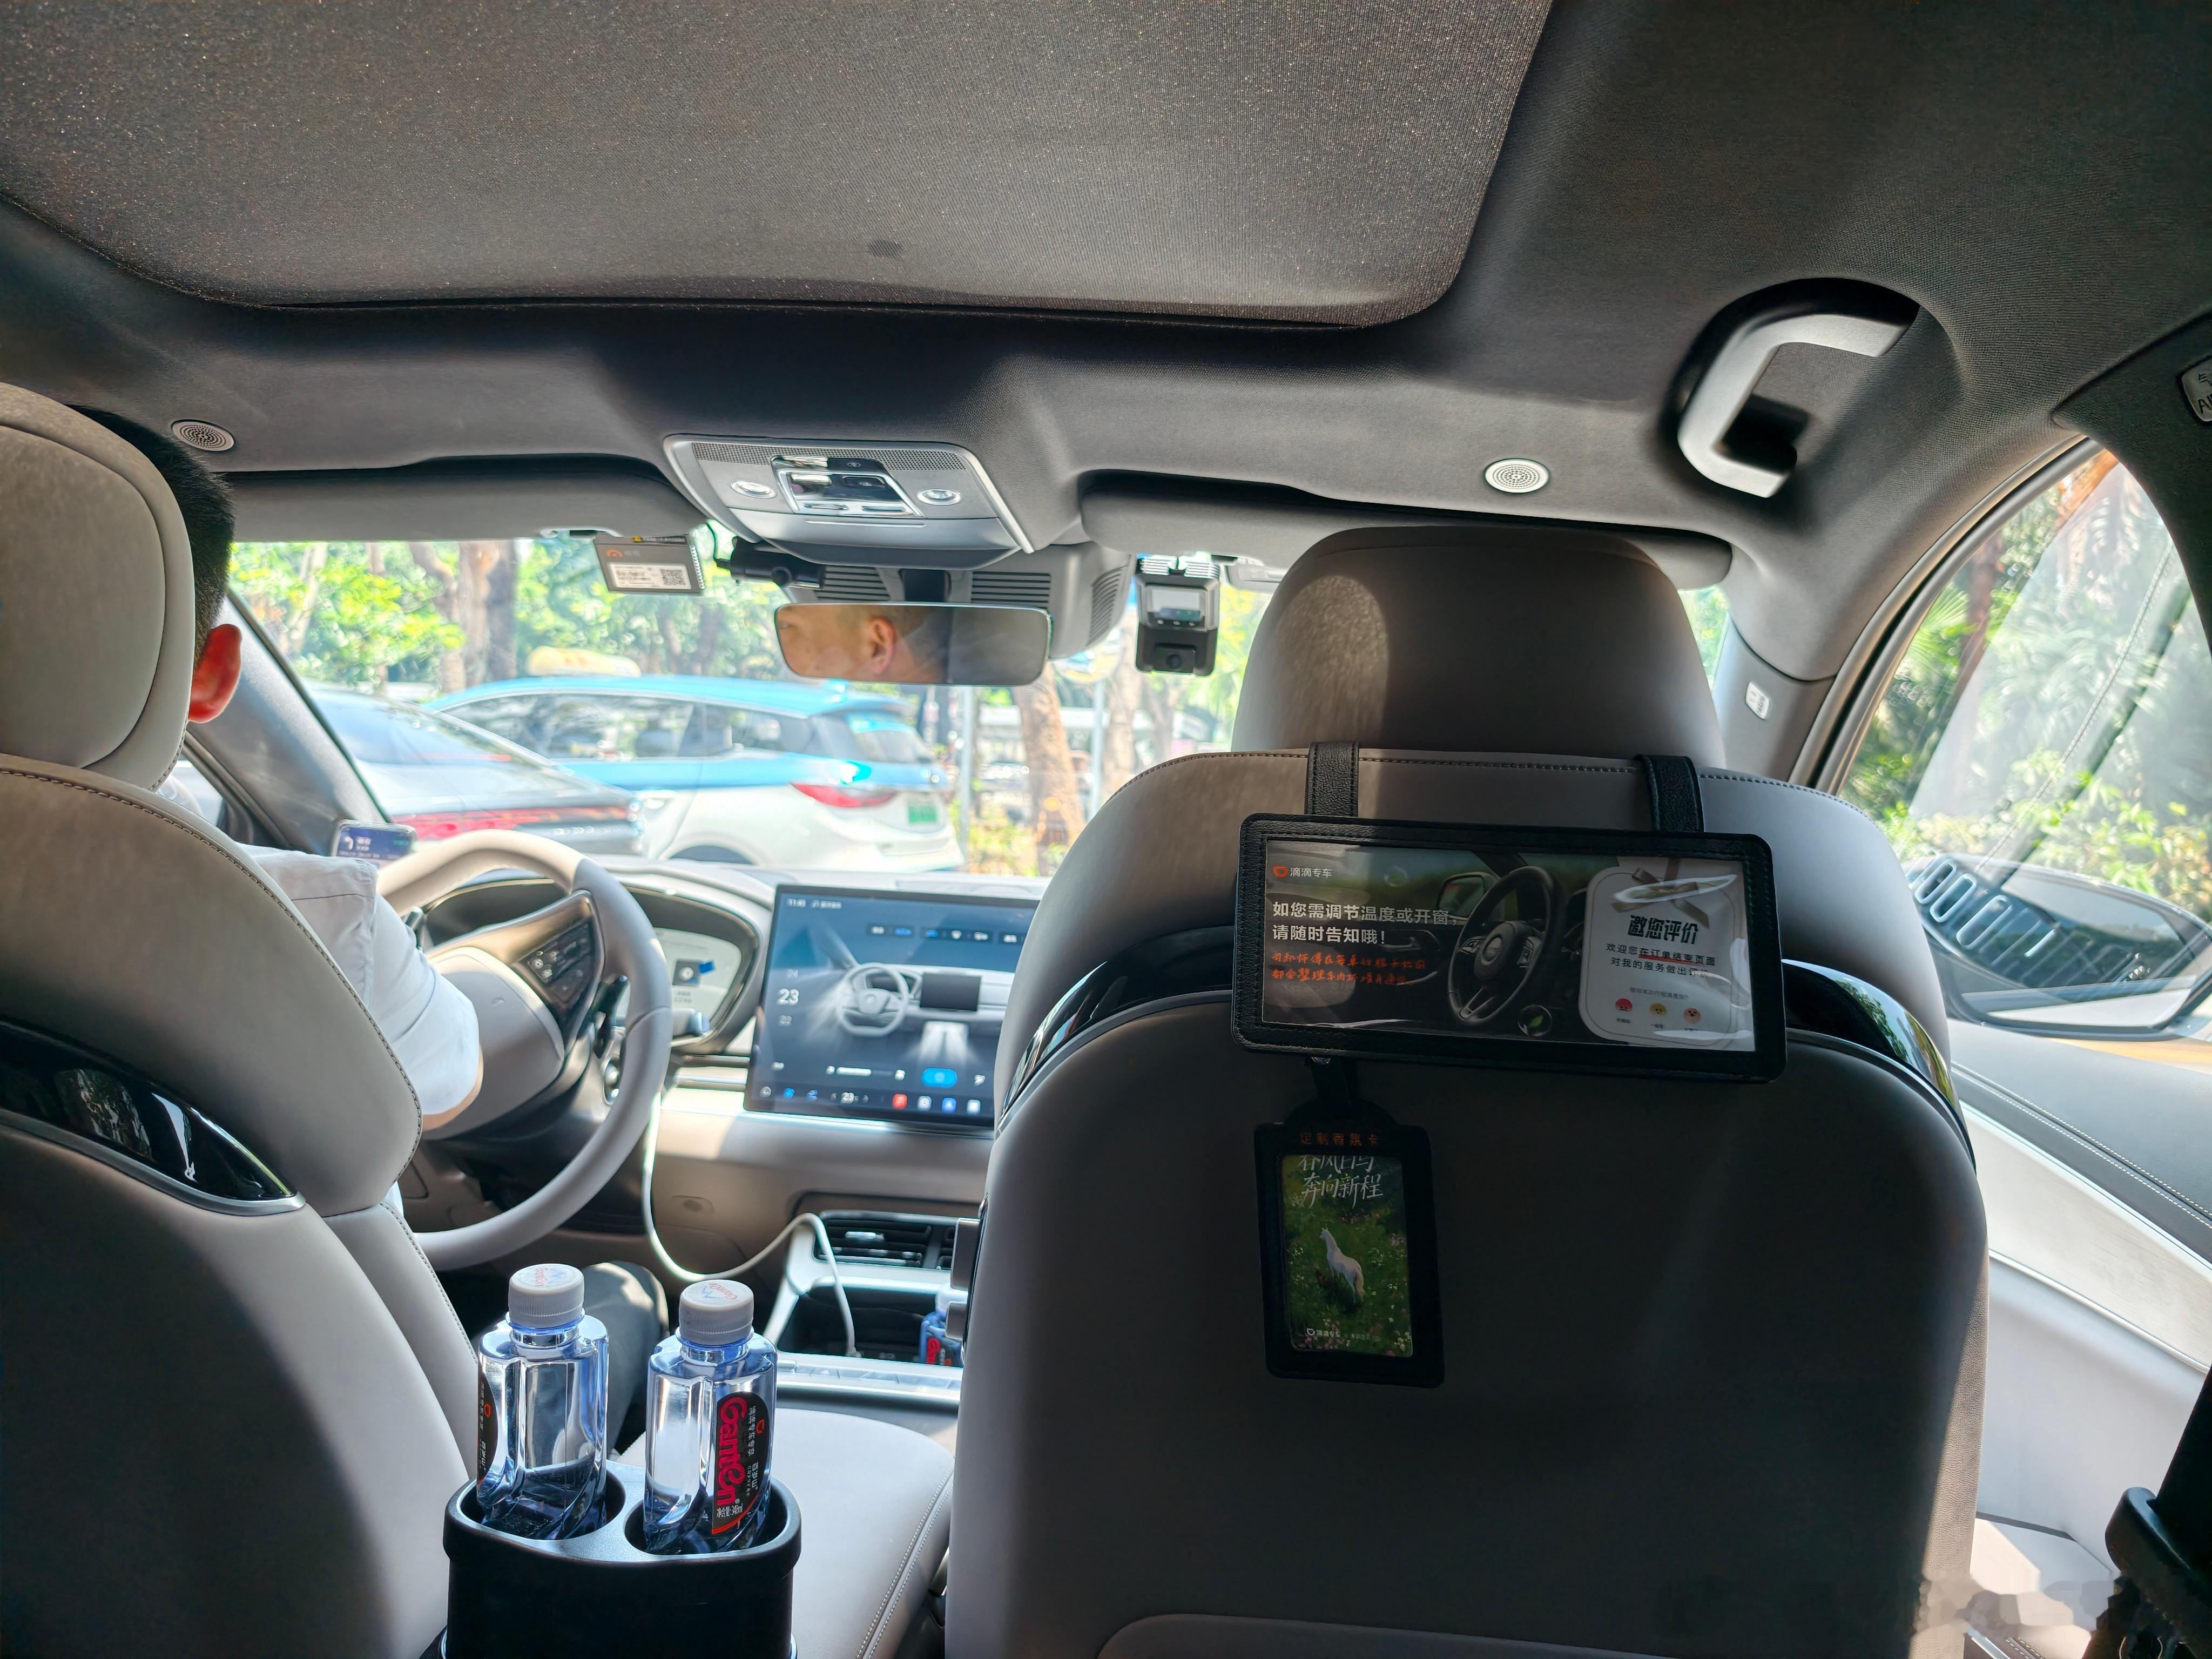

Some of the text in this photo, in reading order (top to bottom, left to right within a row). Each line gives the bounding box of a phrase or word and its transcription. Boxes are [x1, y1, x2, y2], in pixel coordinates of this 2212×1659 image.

[1290, 867, 1332, 878] 滴滴专车
[1628, 915, 1699, 945] 邀您评价
[1606, 943, 1716, 967] 欢迎您在订单结束页面
[777, 988, 799, 1006] 23
[1301, 1171, 1384, 1209] 奔向新程
